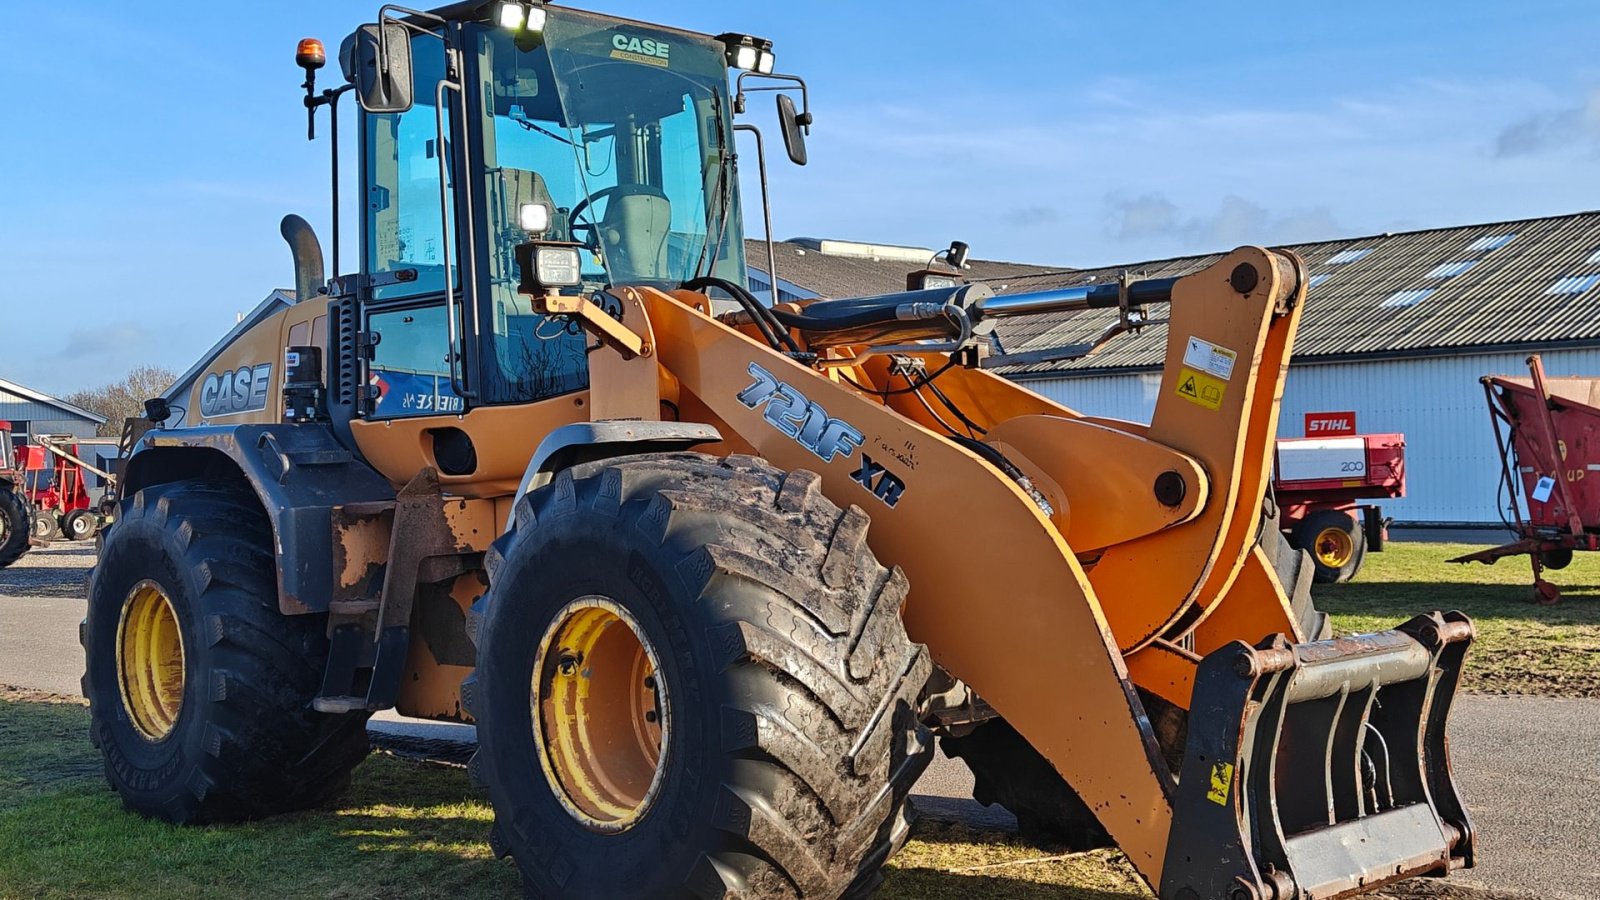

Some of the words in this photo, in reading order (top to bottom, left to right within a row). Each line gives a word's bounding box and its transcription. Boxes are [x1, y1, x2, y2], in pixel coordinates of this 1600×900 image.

[612, 34, 670, 58] CASE
[619, 52, 668, 66] CONSTRUCTION
[201, 364, 269, 417] CASE
[736, 361, 866, 464] 721F
[1308, 419, 1351, 431] STIHL
[1341, 461, 1364, 472] 200
[848, 451, 906, 510] XR
